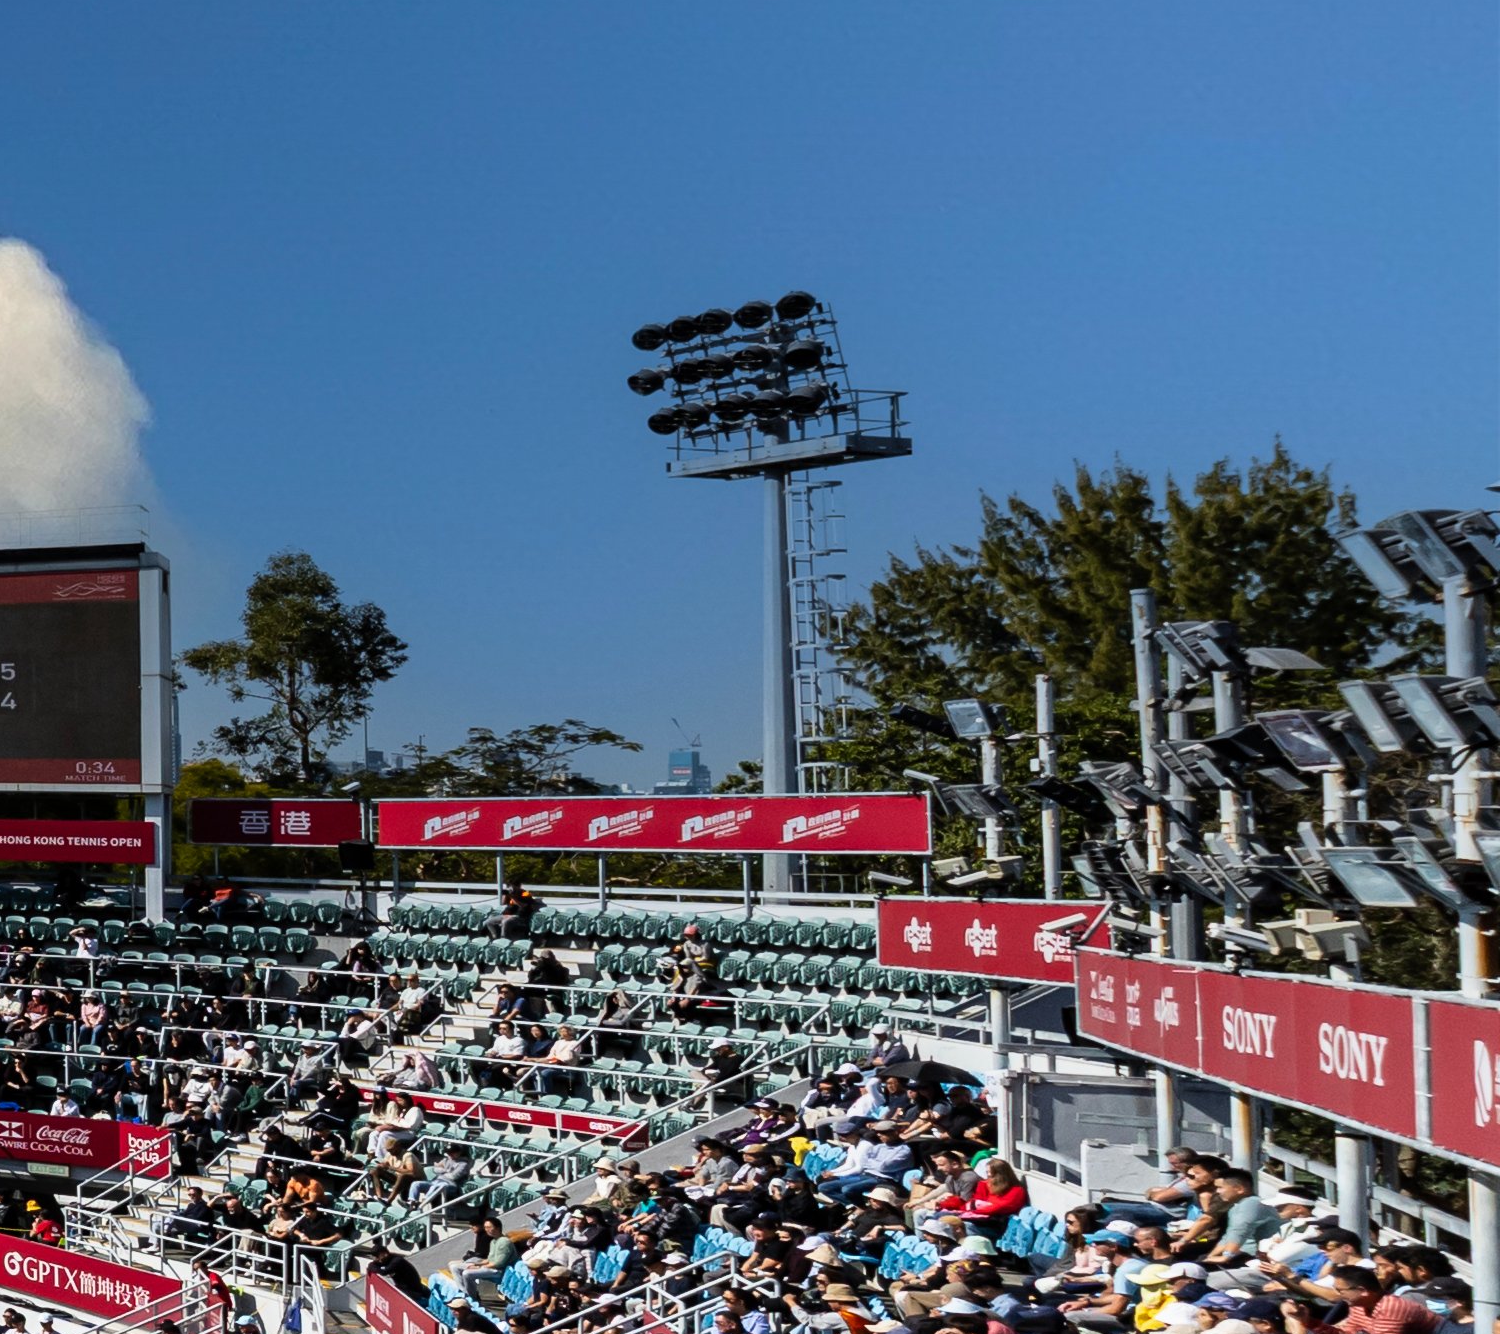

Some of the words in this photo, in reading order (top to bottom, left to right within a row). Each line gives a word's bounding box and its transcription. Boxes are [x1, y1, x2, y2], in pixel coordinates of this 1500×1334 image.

[0, 662, 16, 681] 5
[0, 692, 17, 711] 4
[75, 761, 115, 773] 0:34
[239, 810, 311, 835] 香港
[0, 836, 31, 845] HONG
[33, 836, 65, 846] KONG
[67, 837, 108, 846] TENNIS
[110, 838, 142, 847] OPEN
[1222, 1005, 1277, 1058] SONY
[1318, 1022, 1388, 1086] SONY
[433, 1101, 456, 1112] GUESTS
[508, 1110, 533, 1121] GUESTS
[590, 1120, 615, 1131] GUESTS
[29, 1141, 93, 1157] COCA-COLA
